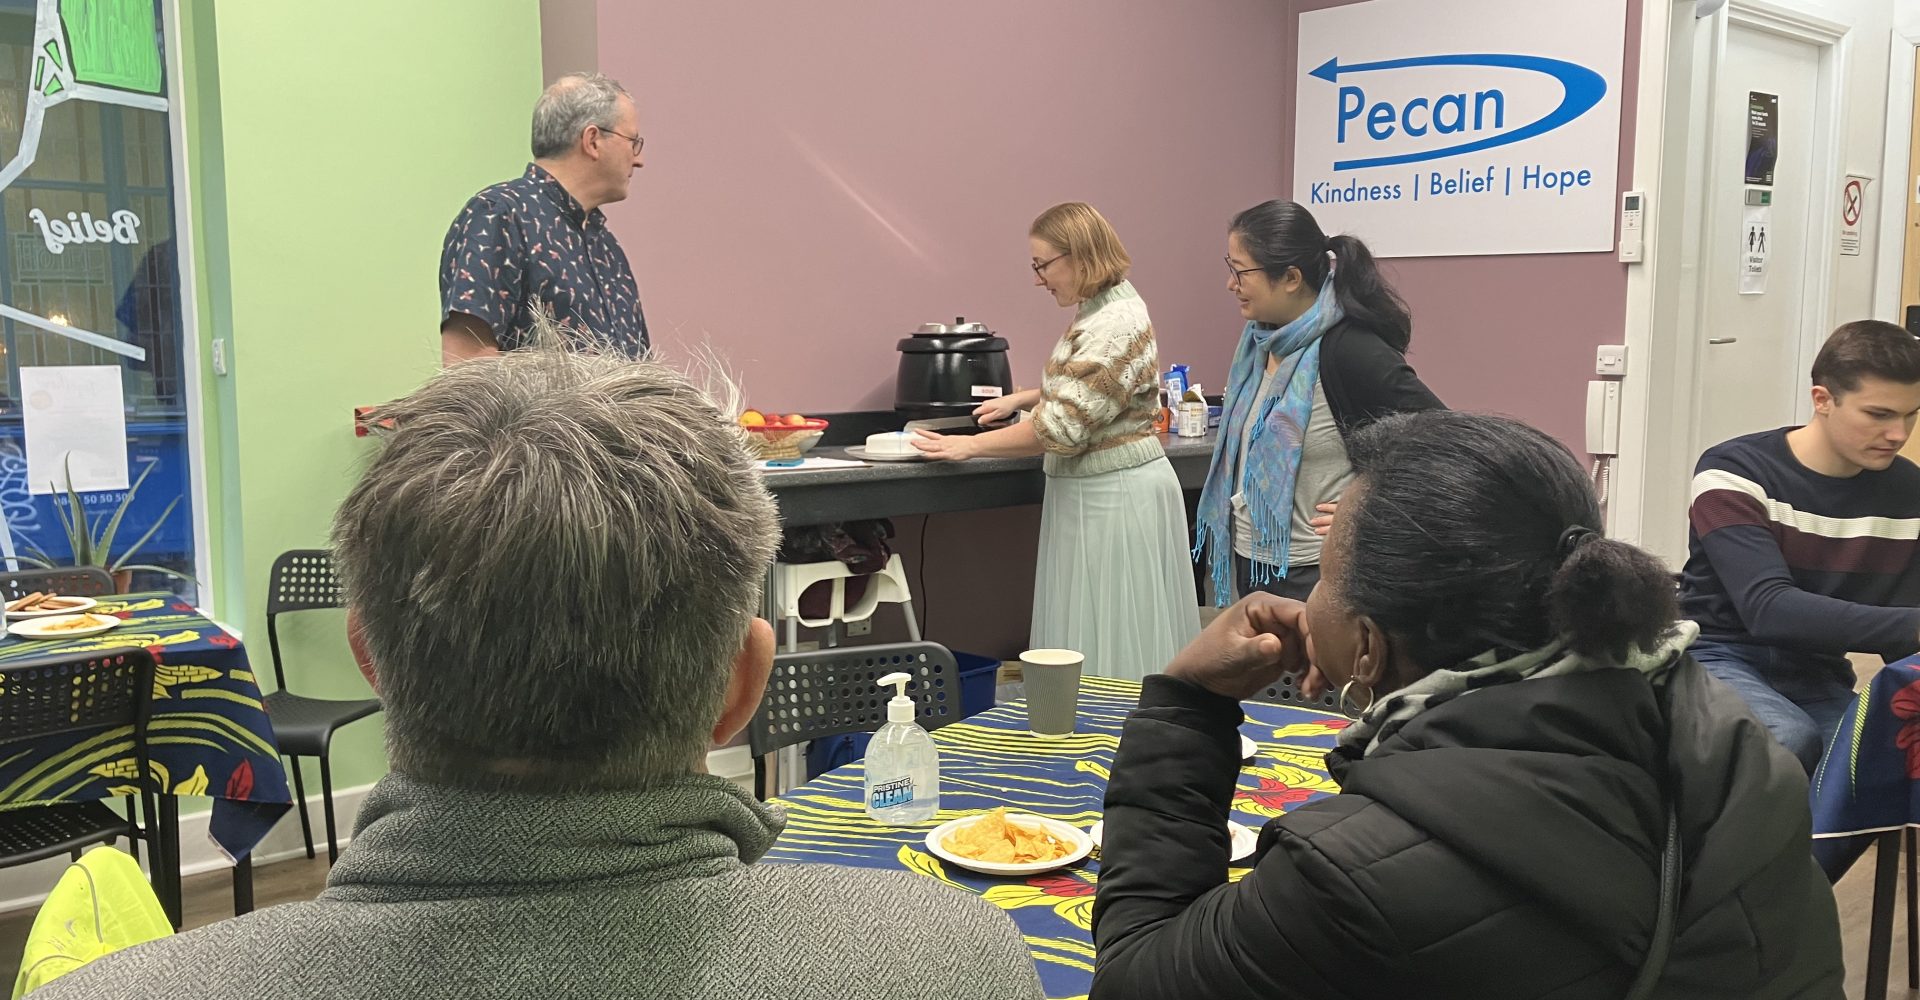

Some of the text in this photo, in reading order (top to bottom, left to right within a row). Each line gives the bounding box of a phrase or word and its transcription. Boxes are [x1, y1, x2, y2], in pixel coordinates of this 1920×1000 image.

[1337, 86, 1505, 143] Pecan
[1311, 179, 1402, 205] Kindness
[1430, 166, 1495, 196] Belief
[1523, 164, 1592, 196] Hope
[83, 494, 97, 505] 50
[100, 493, 113, 504] 50
[871, 785, 914, 809] CLEAN
[873, 777, 911, 793] PRISTINE
